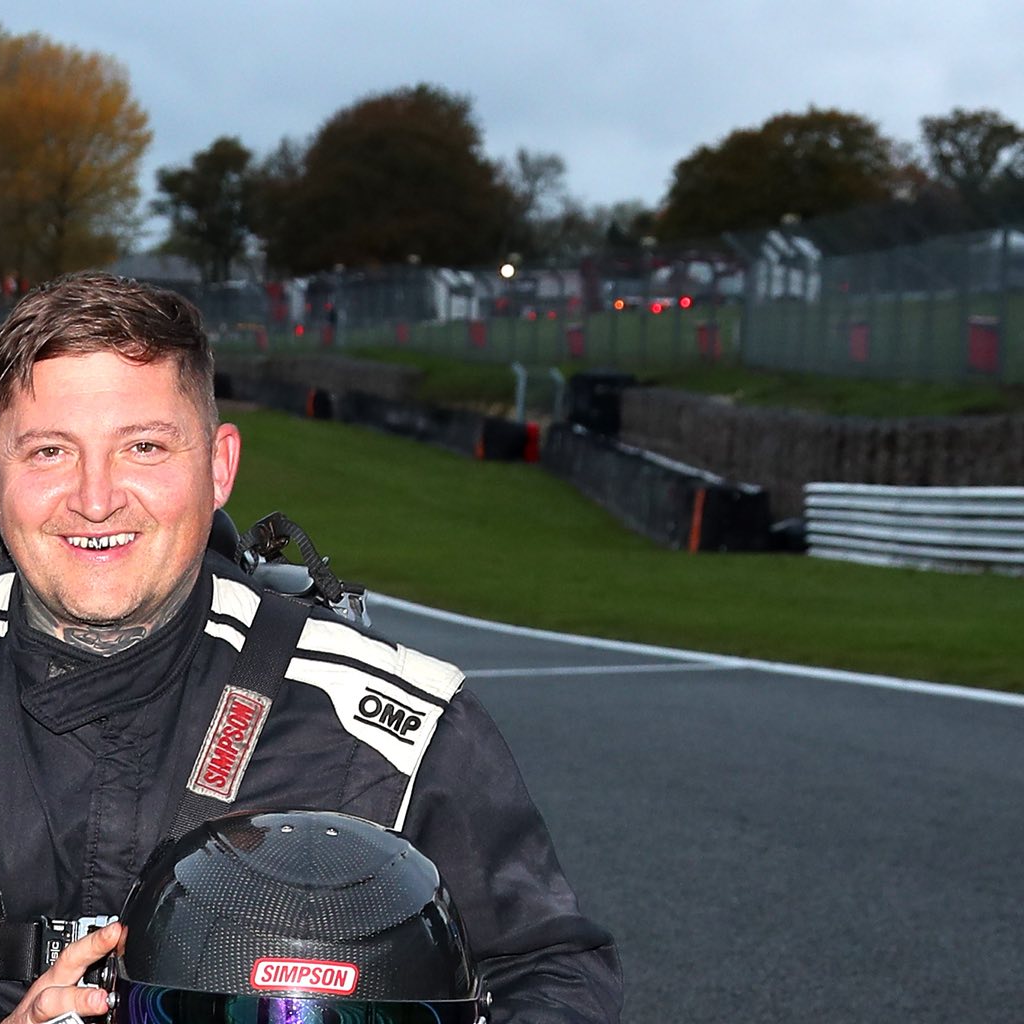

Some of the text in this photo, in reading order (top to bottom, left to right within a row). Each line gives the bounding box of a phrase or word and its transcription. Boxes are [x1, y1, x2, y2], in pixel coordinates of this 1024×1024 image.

[358, 695, 422, 736] OMP
[204, 700, 257, 788] SIMPSON
[261, 964, 348, 987] SIMPSON
